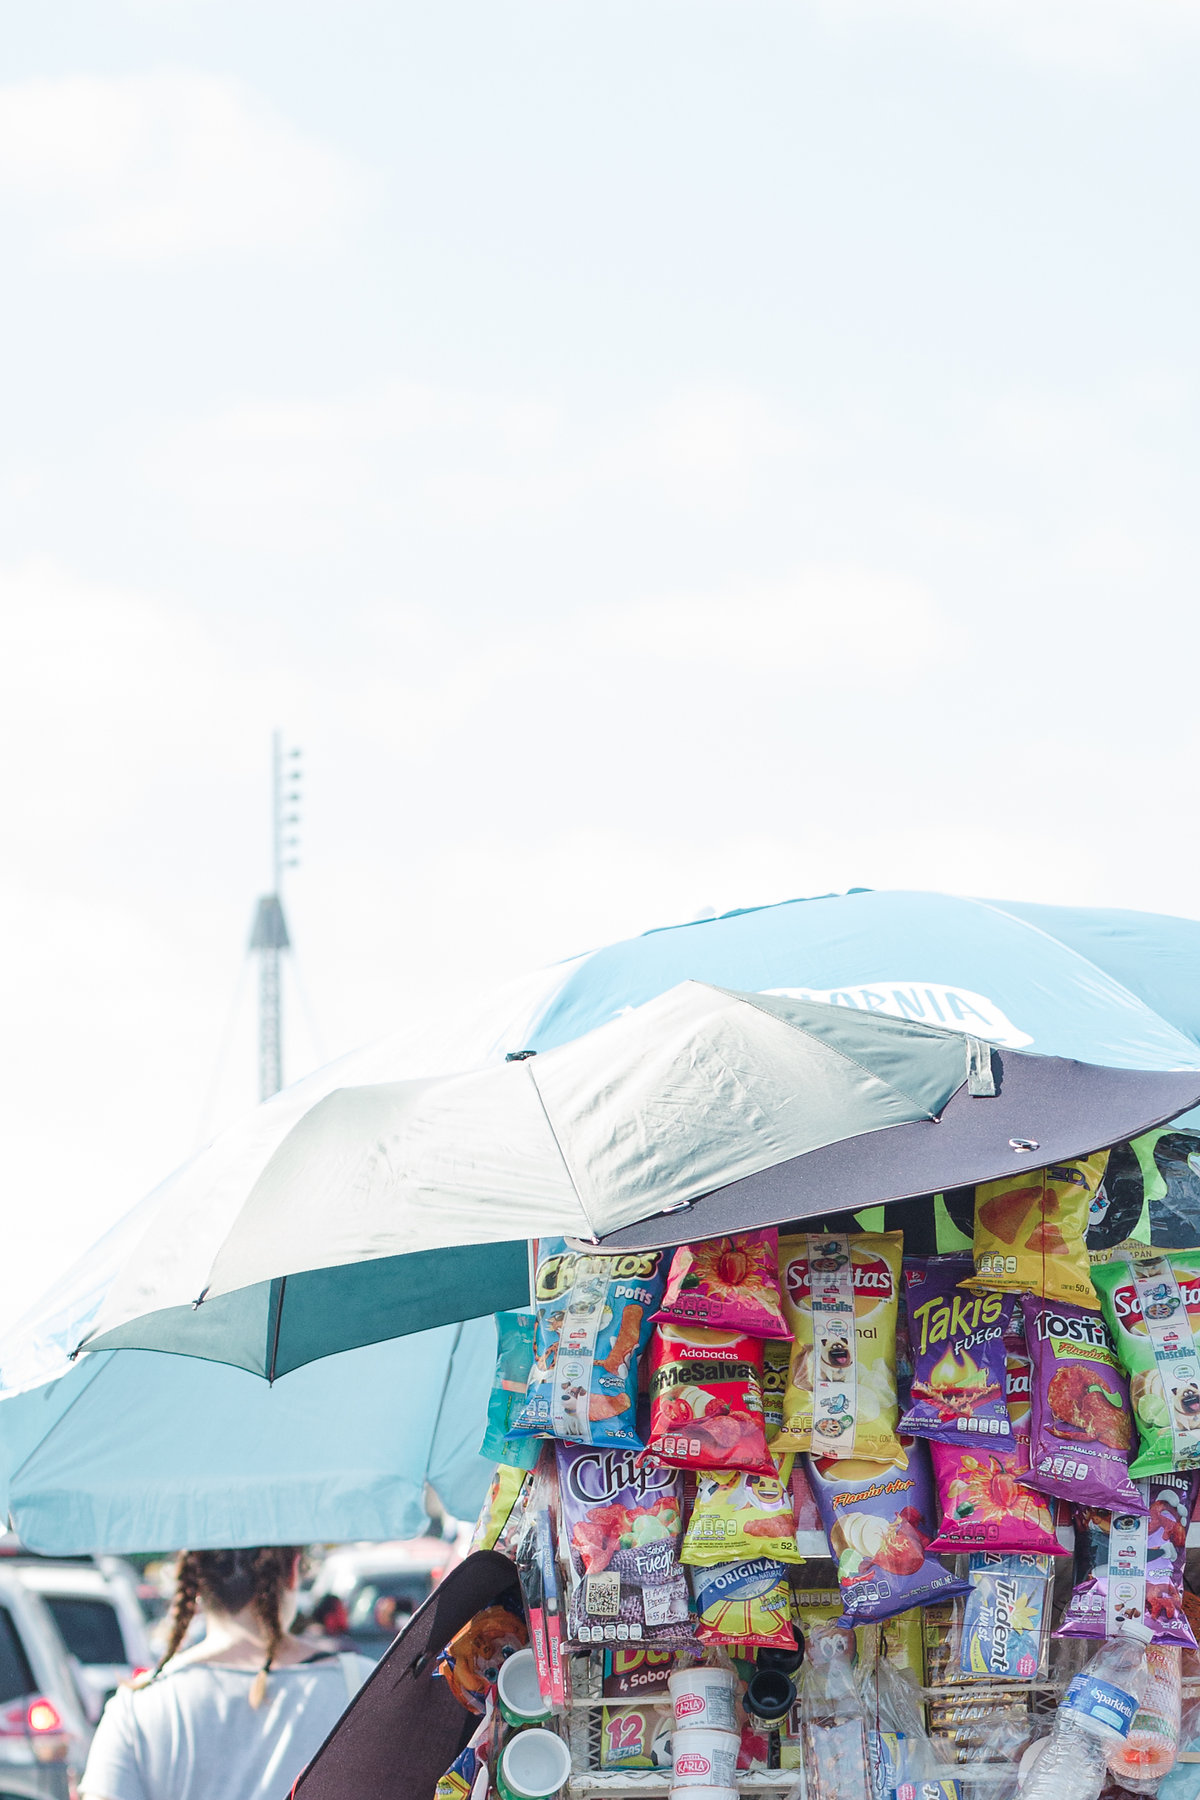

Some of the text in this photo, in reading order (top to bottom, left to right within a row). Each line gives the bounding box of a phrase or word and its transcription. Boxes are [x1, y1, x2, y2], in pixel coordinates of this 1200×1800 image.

[1075, 1284, 1085, 1292] 50
[913, 1292, 1003, 1356] Takis
[953, 1327, 1002, 1356] FUEGO
[679, 1348, 739, 1360] Adobadas
[614, 1430, 626, 1438] 45
[885, 1477, 915, 1495] Hot
[1149, 1472, 1190, 1491] millos
[646, 1544, 667, 1556] Sabor
[780, 1541, 792, 1550] 52
[634, 1549, 674, 1577] Fuego
[714, 1558, 781, 1589] ORIGINAL
[652, 1612, 660, 1620] 55
[976, 1605, 995, 1642] Twist
[990, 1580, 1018, 1674] Trident
[1170, 1621, 1182, 1630] 27
[619, 1677, 629, 1691] 4
[1094, 1690, 1133, 1718] Sparkletts
[606, 1712, 645, 1750] 12
[678, 1761, 705, 1773] KARLA
